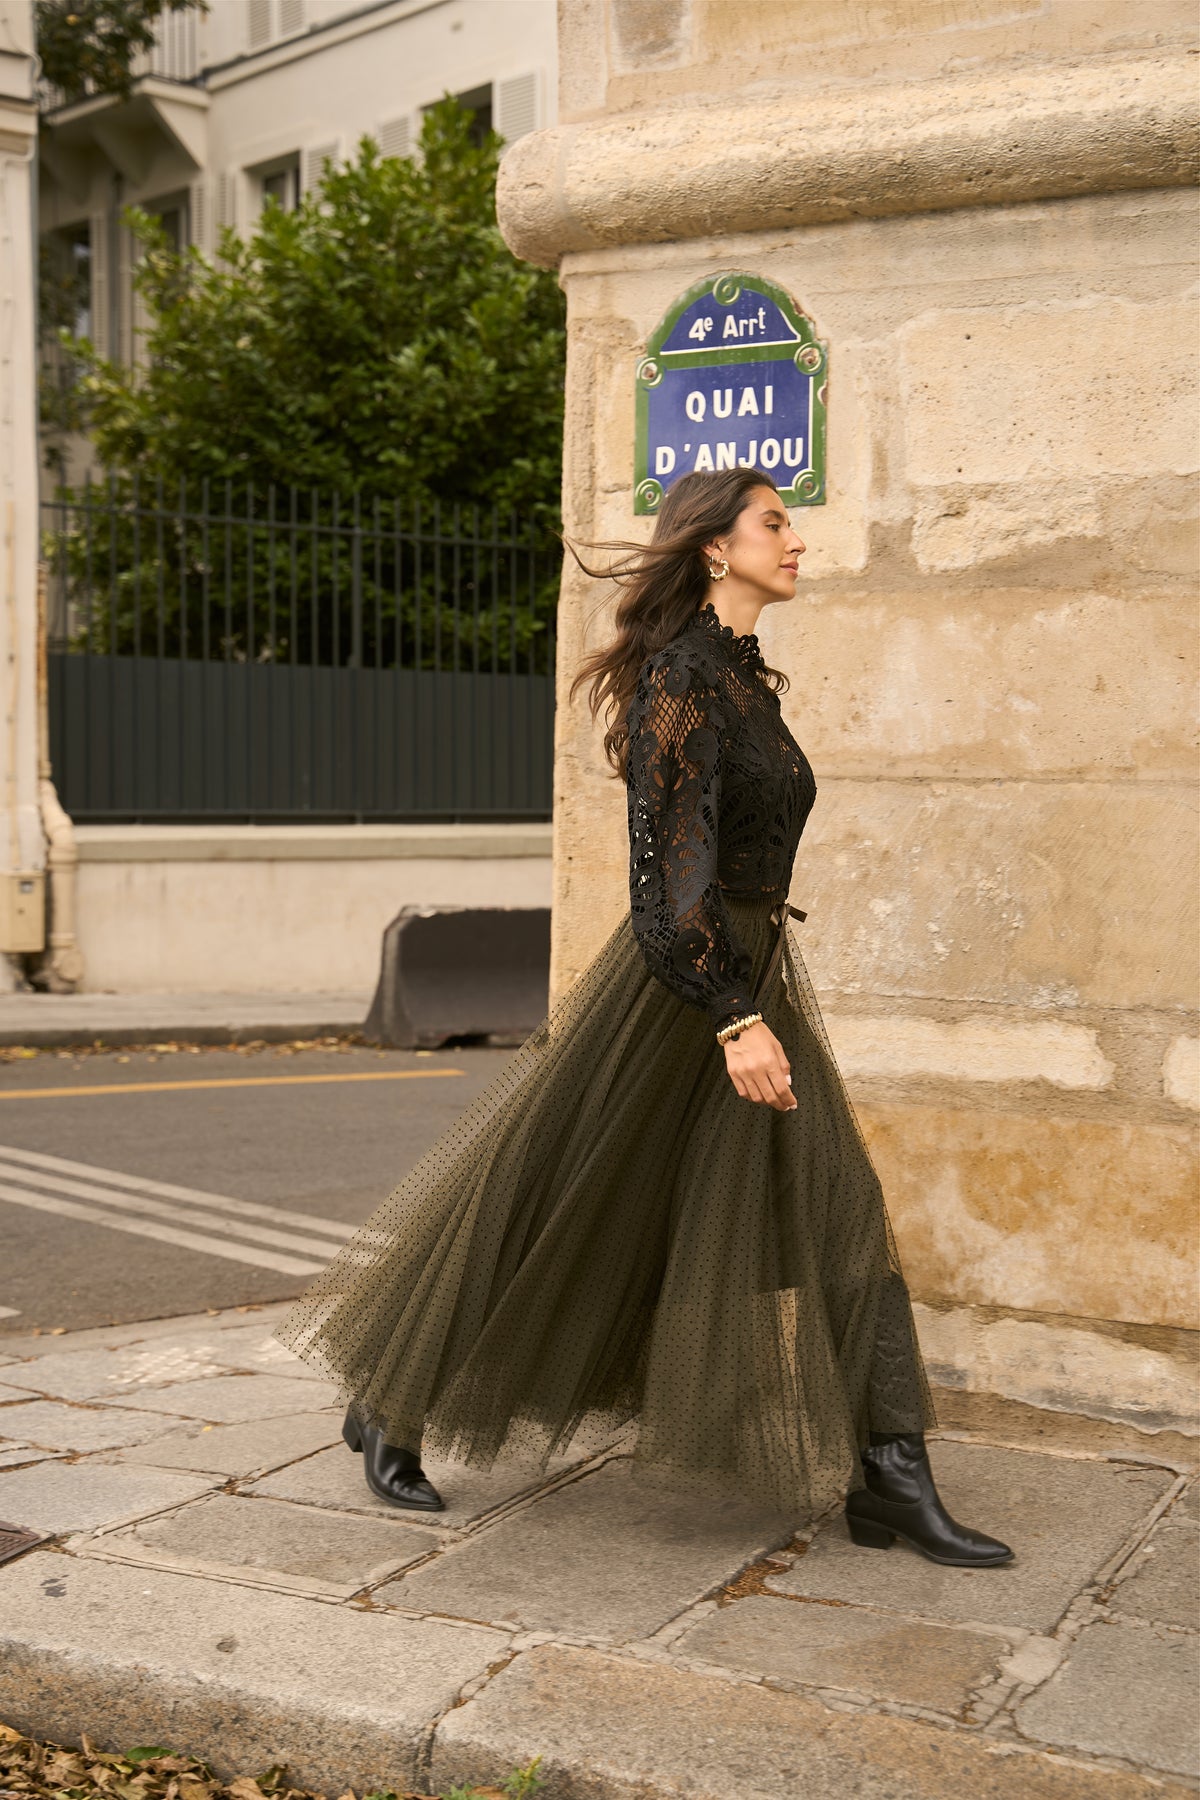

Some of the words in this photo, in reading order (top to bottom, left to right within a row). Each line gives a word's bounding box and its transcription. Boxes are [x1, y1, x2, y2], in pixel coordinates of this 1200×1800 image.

[689, 317, 713, 341] 4e
[685, 385, 773, 422] QUAI
[655, 437, 804, 475] D'ANJOU
